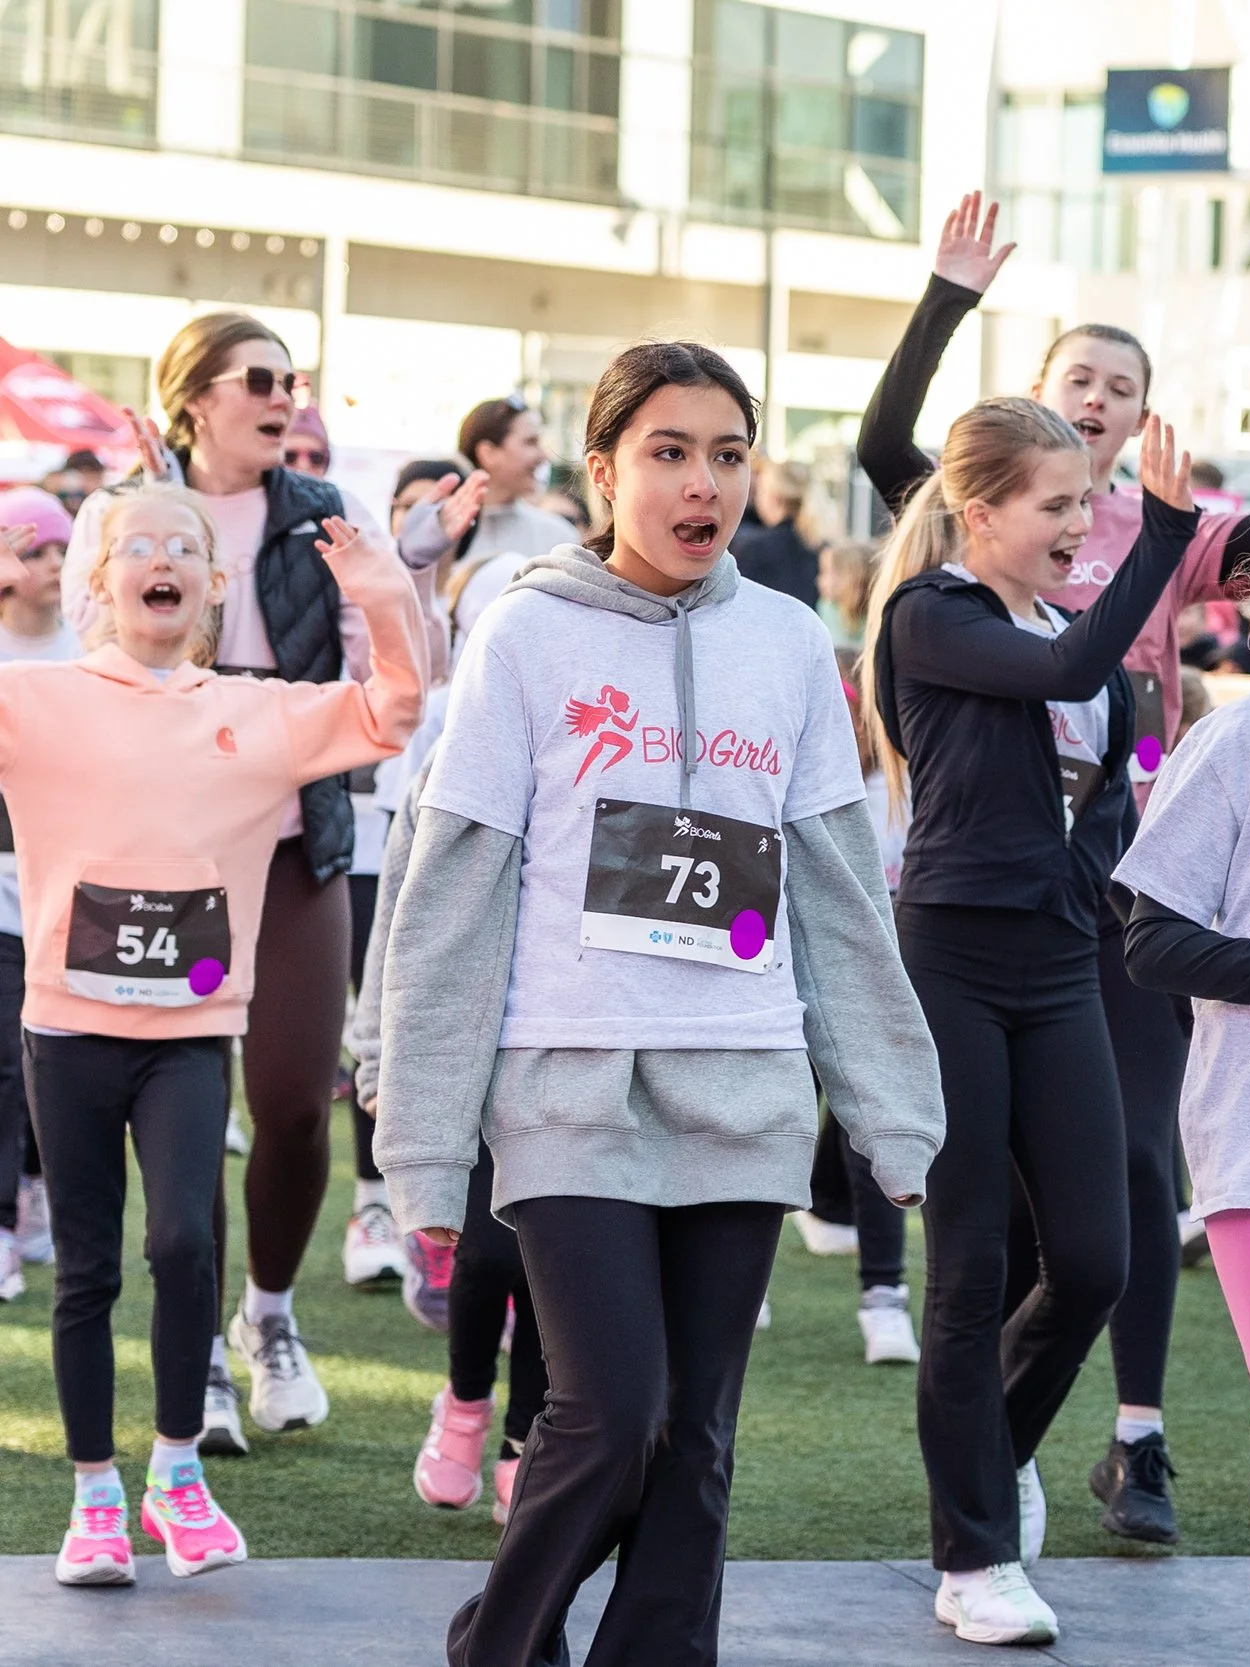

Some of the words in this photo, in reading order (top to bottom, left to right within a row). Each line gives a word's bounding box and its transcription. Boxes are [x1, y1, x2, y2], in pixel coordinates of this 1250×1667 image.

[642, 726, 782, 776] BIOGirls
[661, 854, 721, 909] 73
[116, 924, 179, 967] 54
[678, 936, 694, 946] ND
